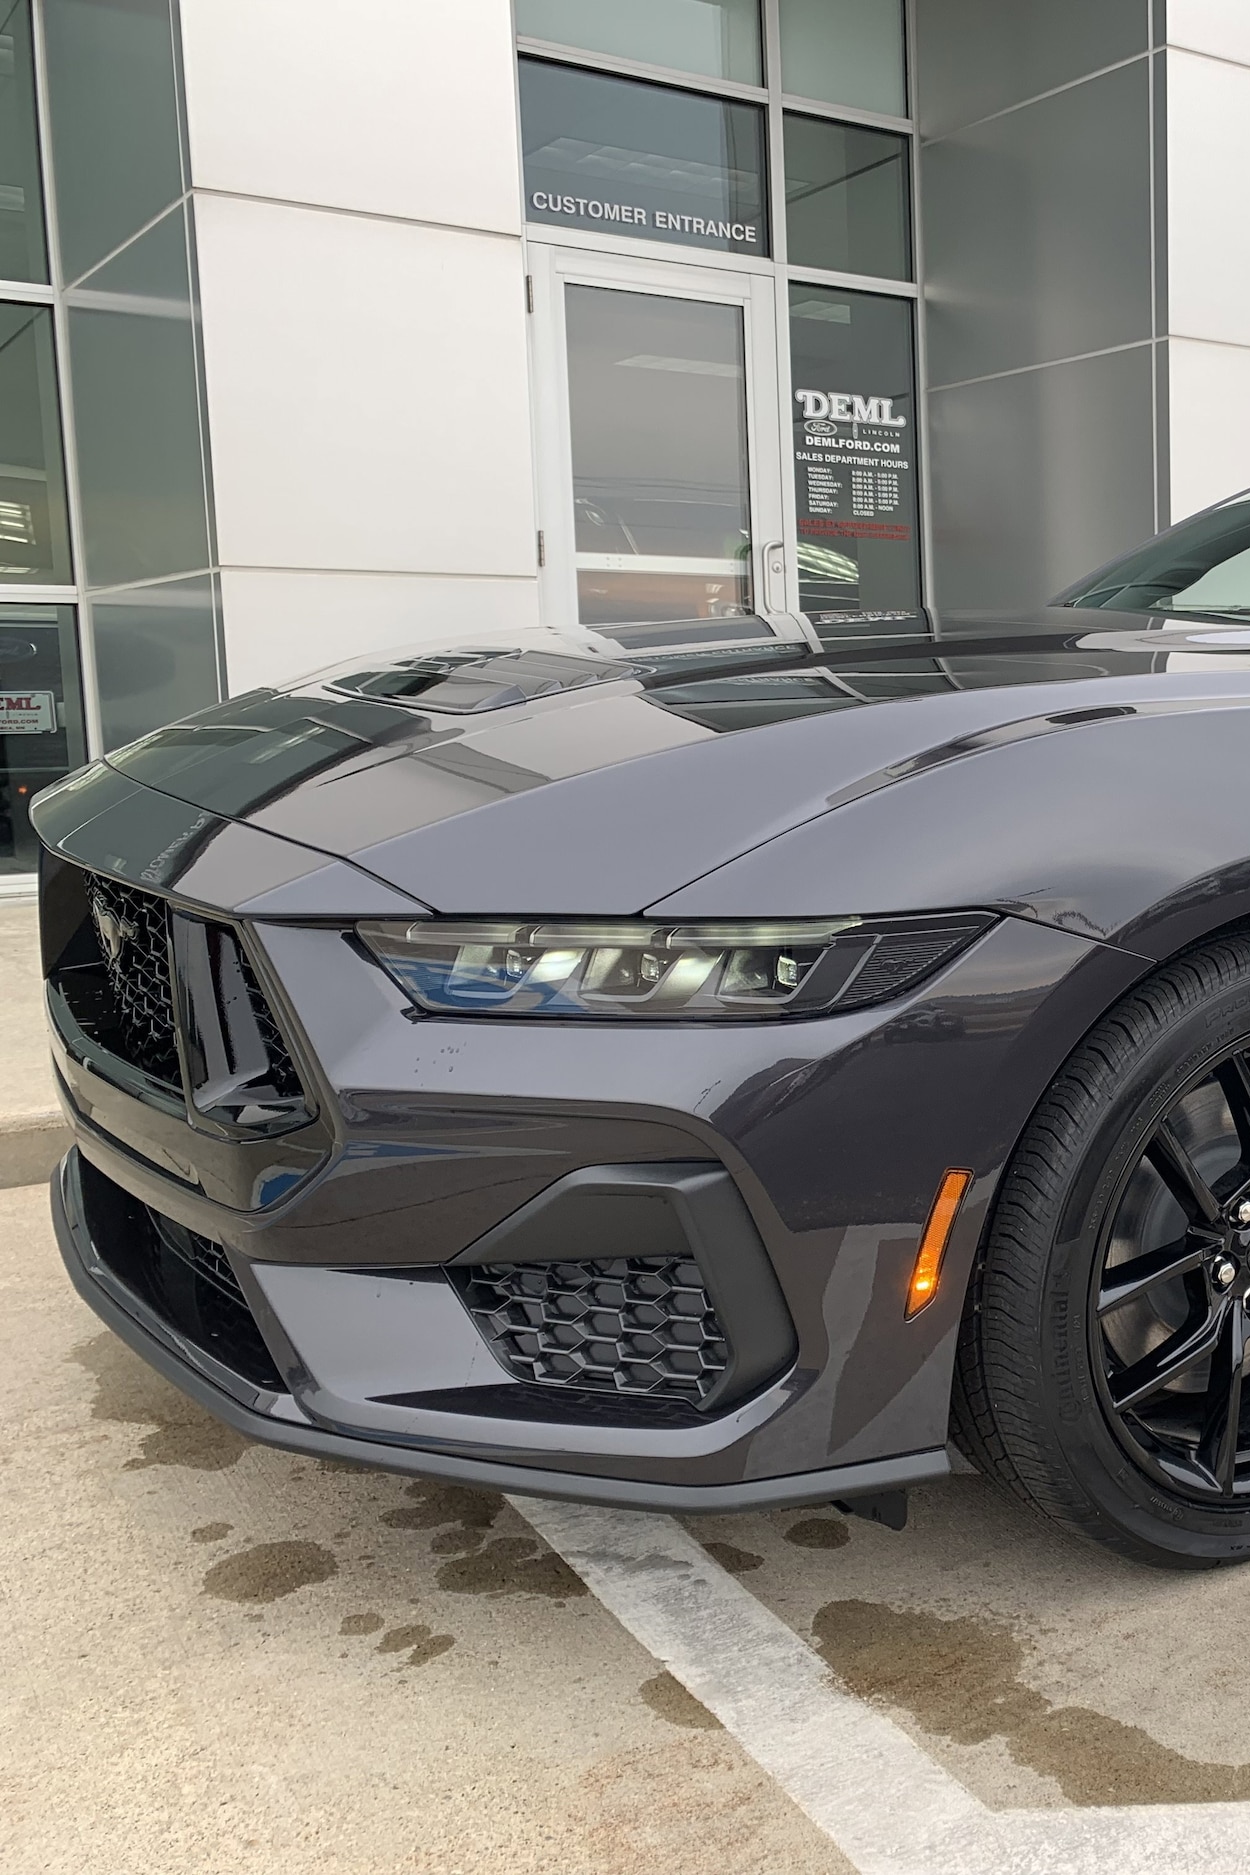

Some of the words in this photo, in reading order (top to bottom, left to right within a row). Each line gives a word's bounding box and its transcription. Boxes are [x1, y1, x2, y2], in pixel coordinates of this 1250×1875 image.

[532, 191, 647, 226] CUSTOMER
[655, 210, 757, 243] ENTRANCE
[795, 389, 906, 427] DEML
[862, 429, 901, 438] LINCOLN
[805, 435, 901, 453] DEMLFORD.COM
[796, 452, 823, 462] SALES
[825, 454, 880, 467] DEPARTMENT
[880, 458, 909, 470] HOURS
